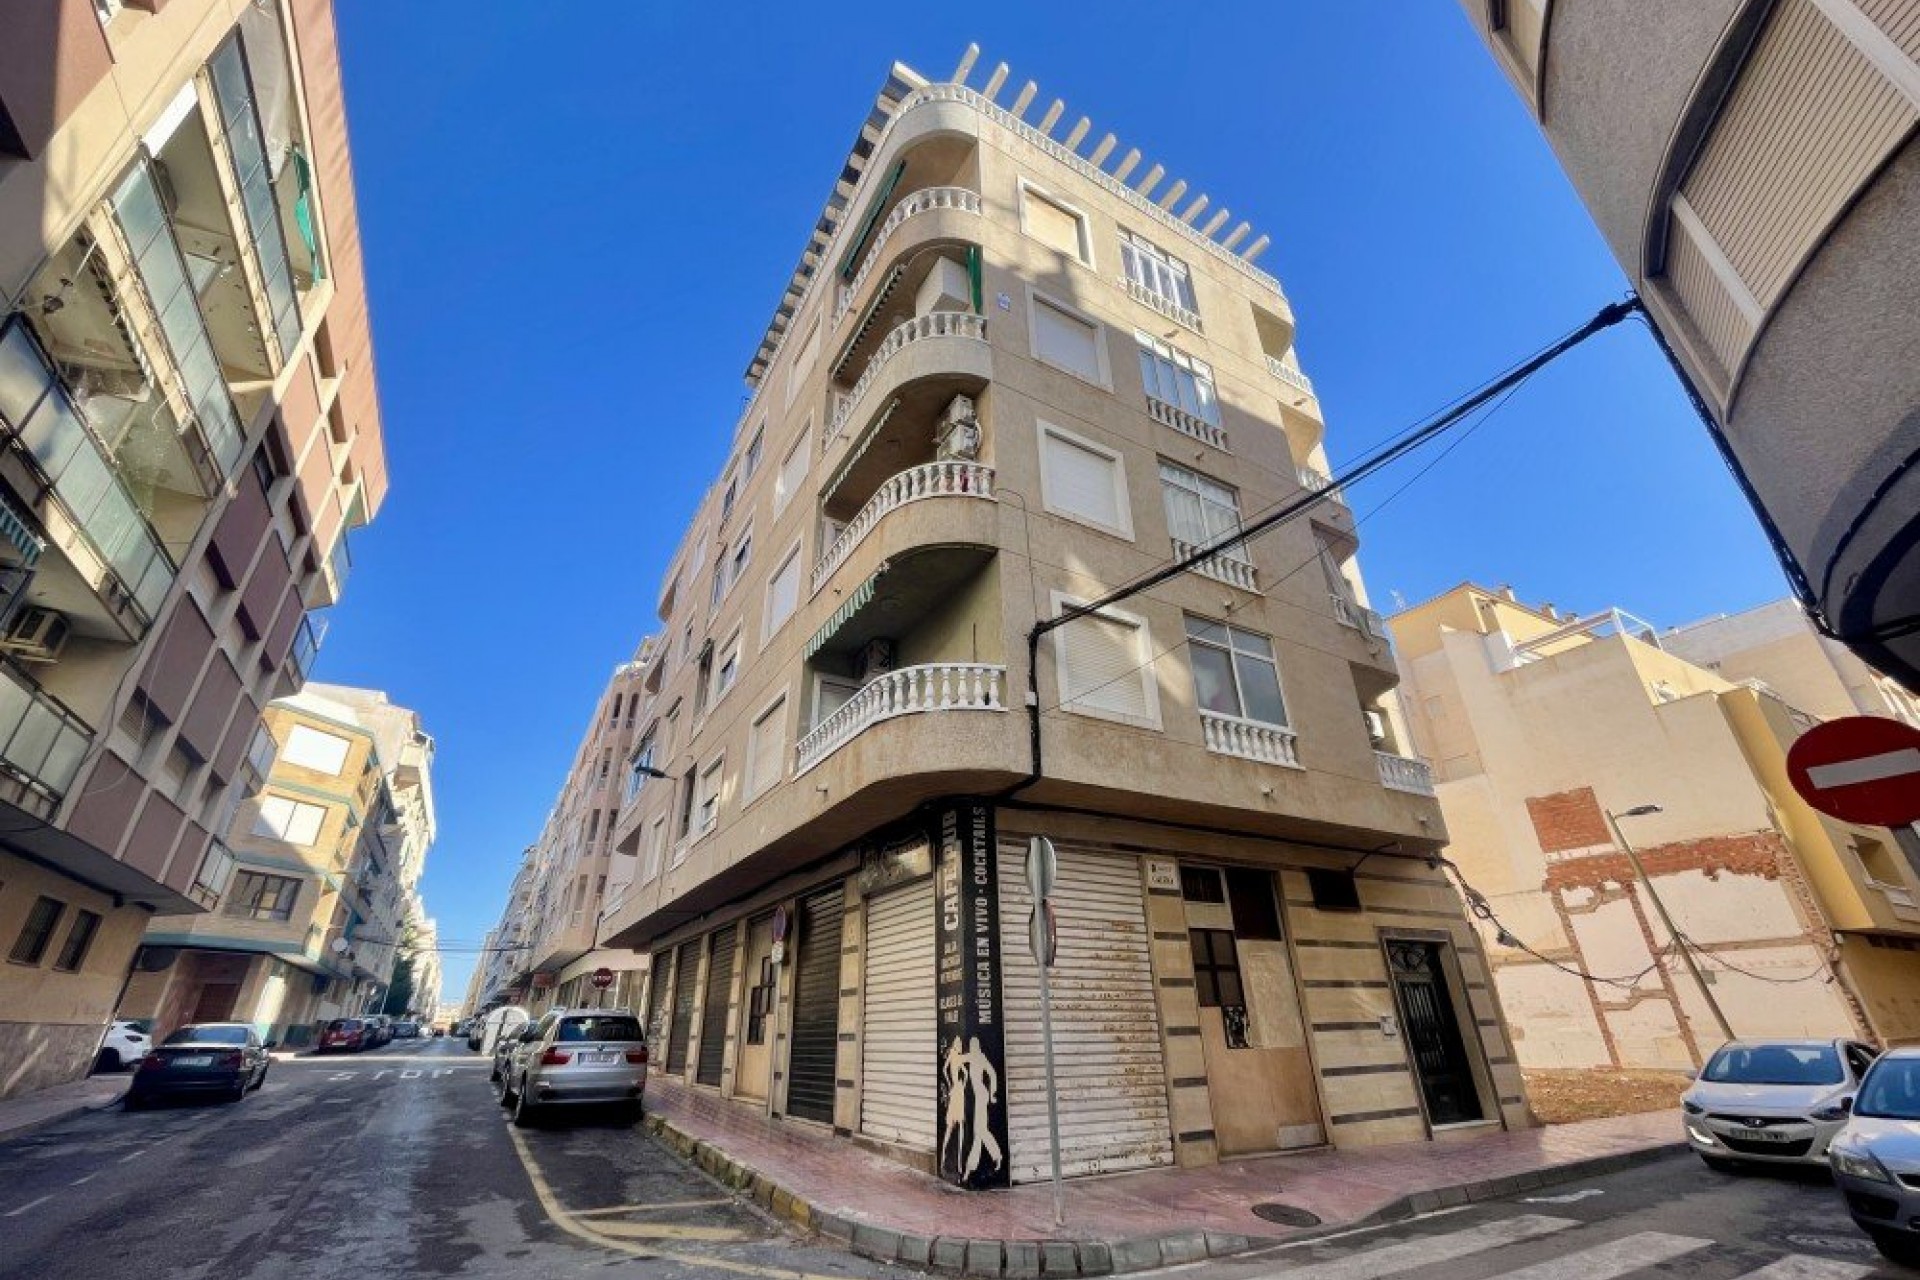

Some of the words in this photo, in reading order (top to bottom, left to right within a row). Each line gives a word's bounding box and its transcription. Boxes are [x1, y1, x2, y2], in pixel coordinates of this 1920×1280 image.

[942, 810, 957, 861] PUB
[972, 806, 988, 885] COCKTAILS
[974, 897, 989, 933] VIVO
[976, 937, 990, 957] EN
[974, 961, 992, 1024] MÚSICA
[327, 1068, 455, 1081] STOP
